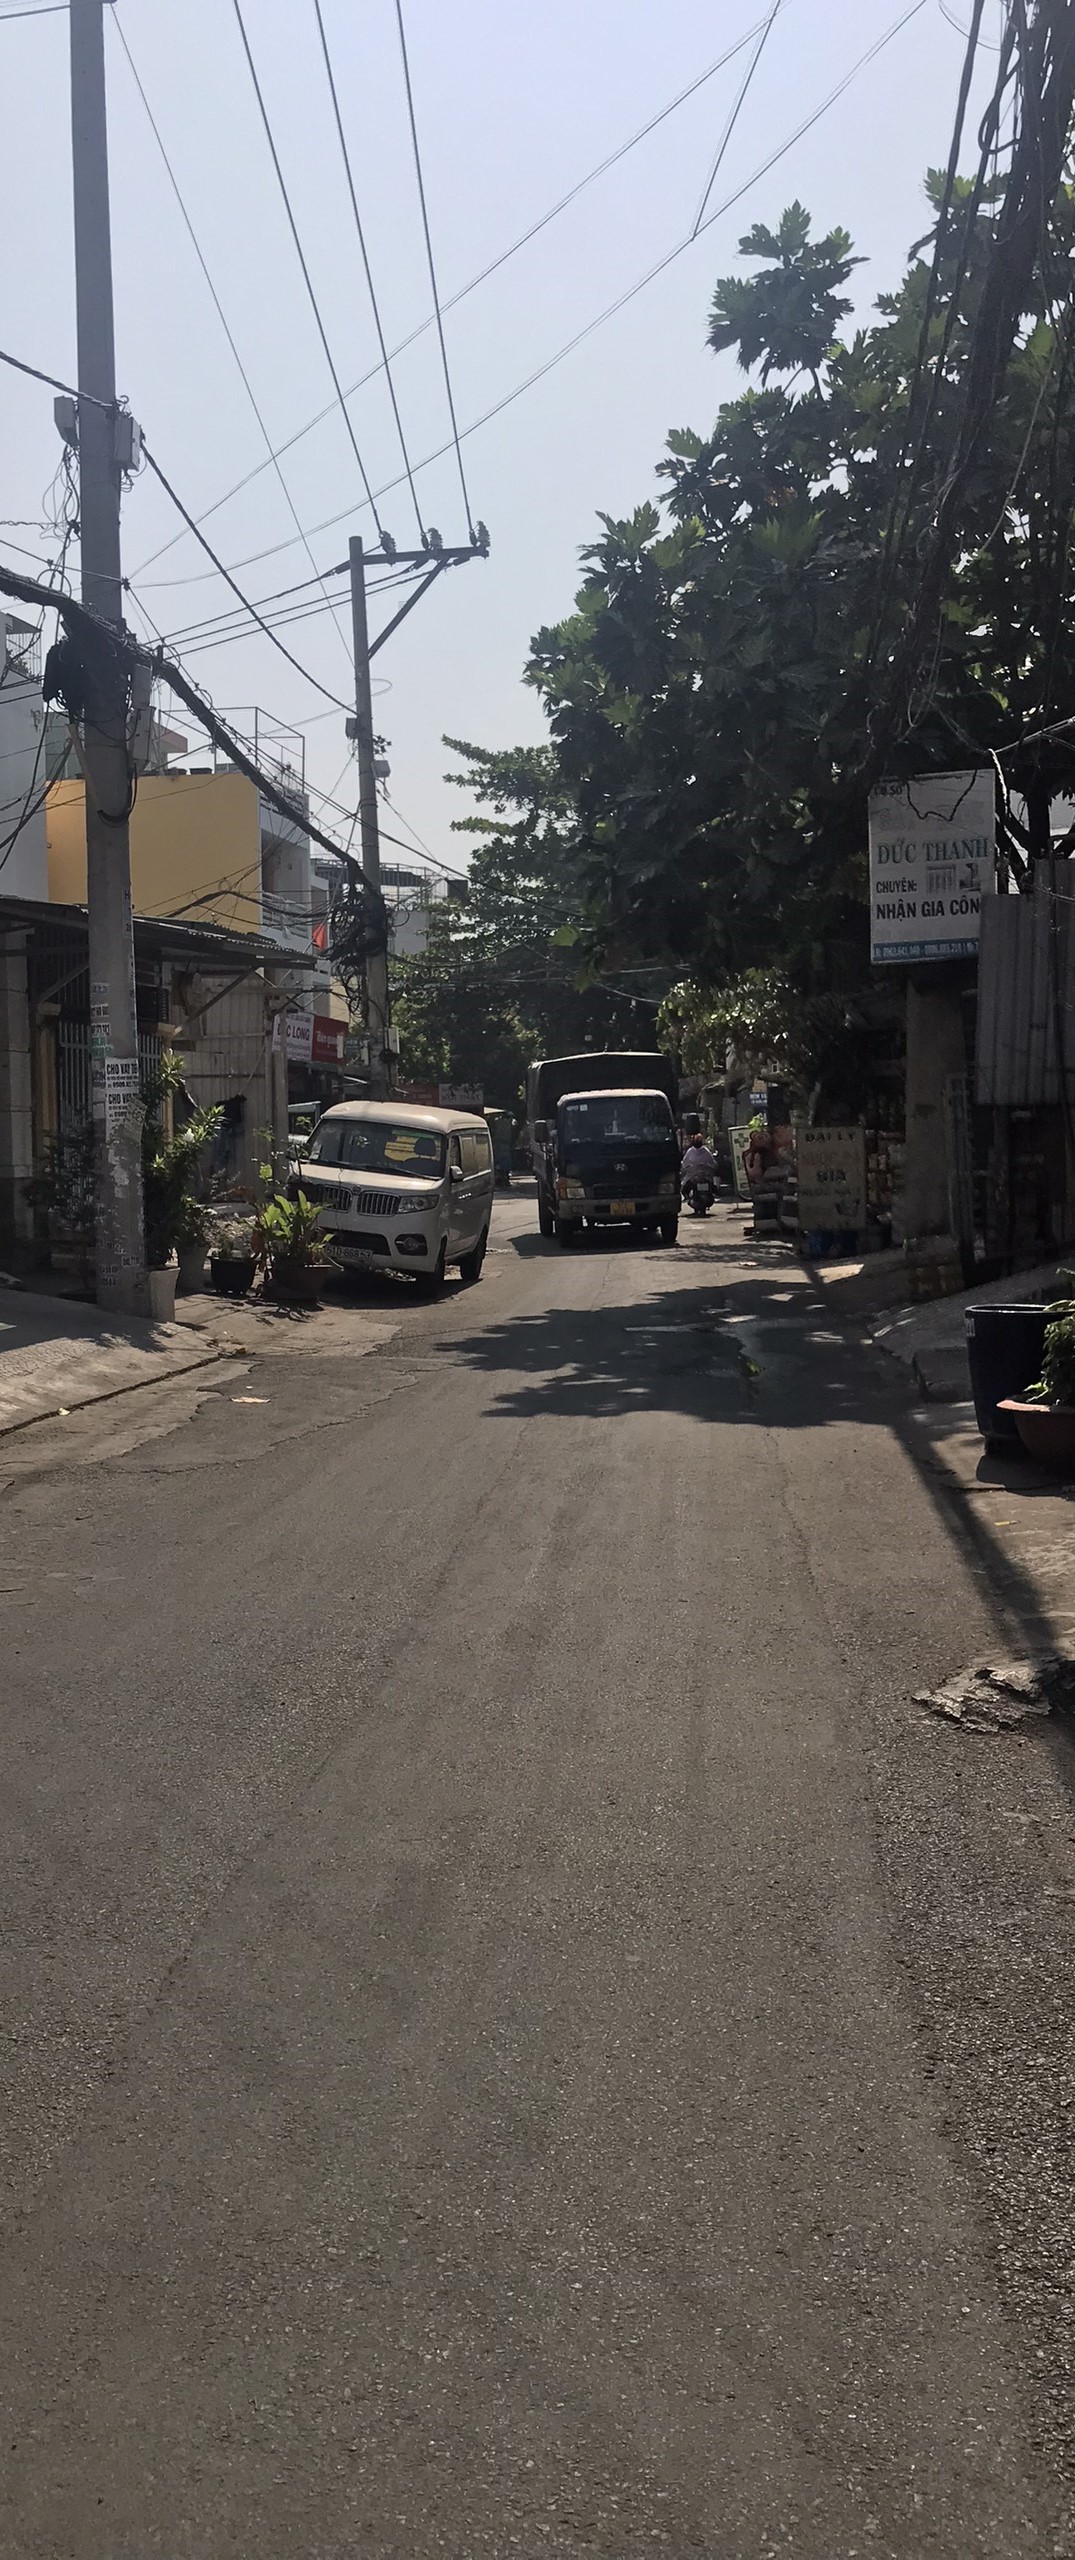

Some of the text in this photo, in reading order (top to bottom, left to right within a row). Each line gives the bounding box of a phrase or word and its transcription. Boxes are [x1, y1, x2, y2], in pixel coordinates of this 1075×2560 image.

[877, 837, 917, 864] ĐỨC
[876, 898, 917, 921] NHẬN
[921, 900, 945, 917] GIA
[292, 1026, 310, 1041] LONG
[106, 1063, 120, 1075] CHO
[108, 1093, 121, 1105] CHO
